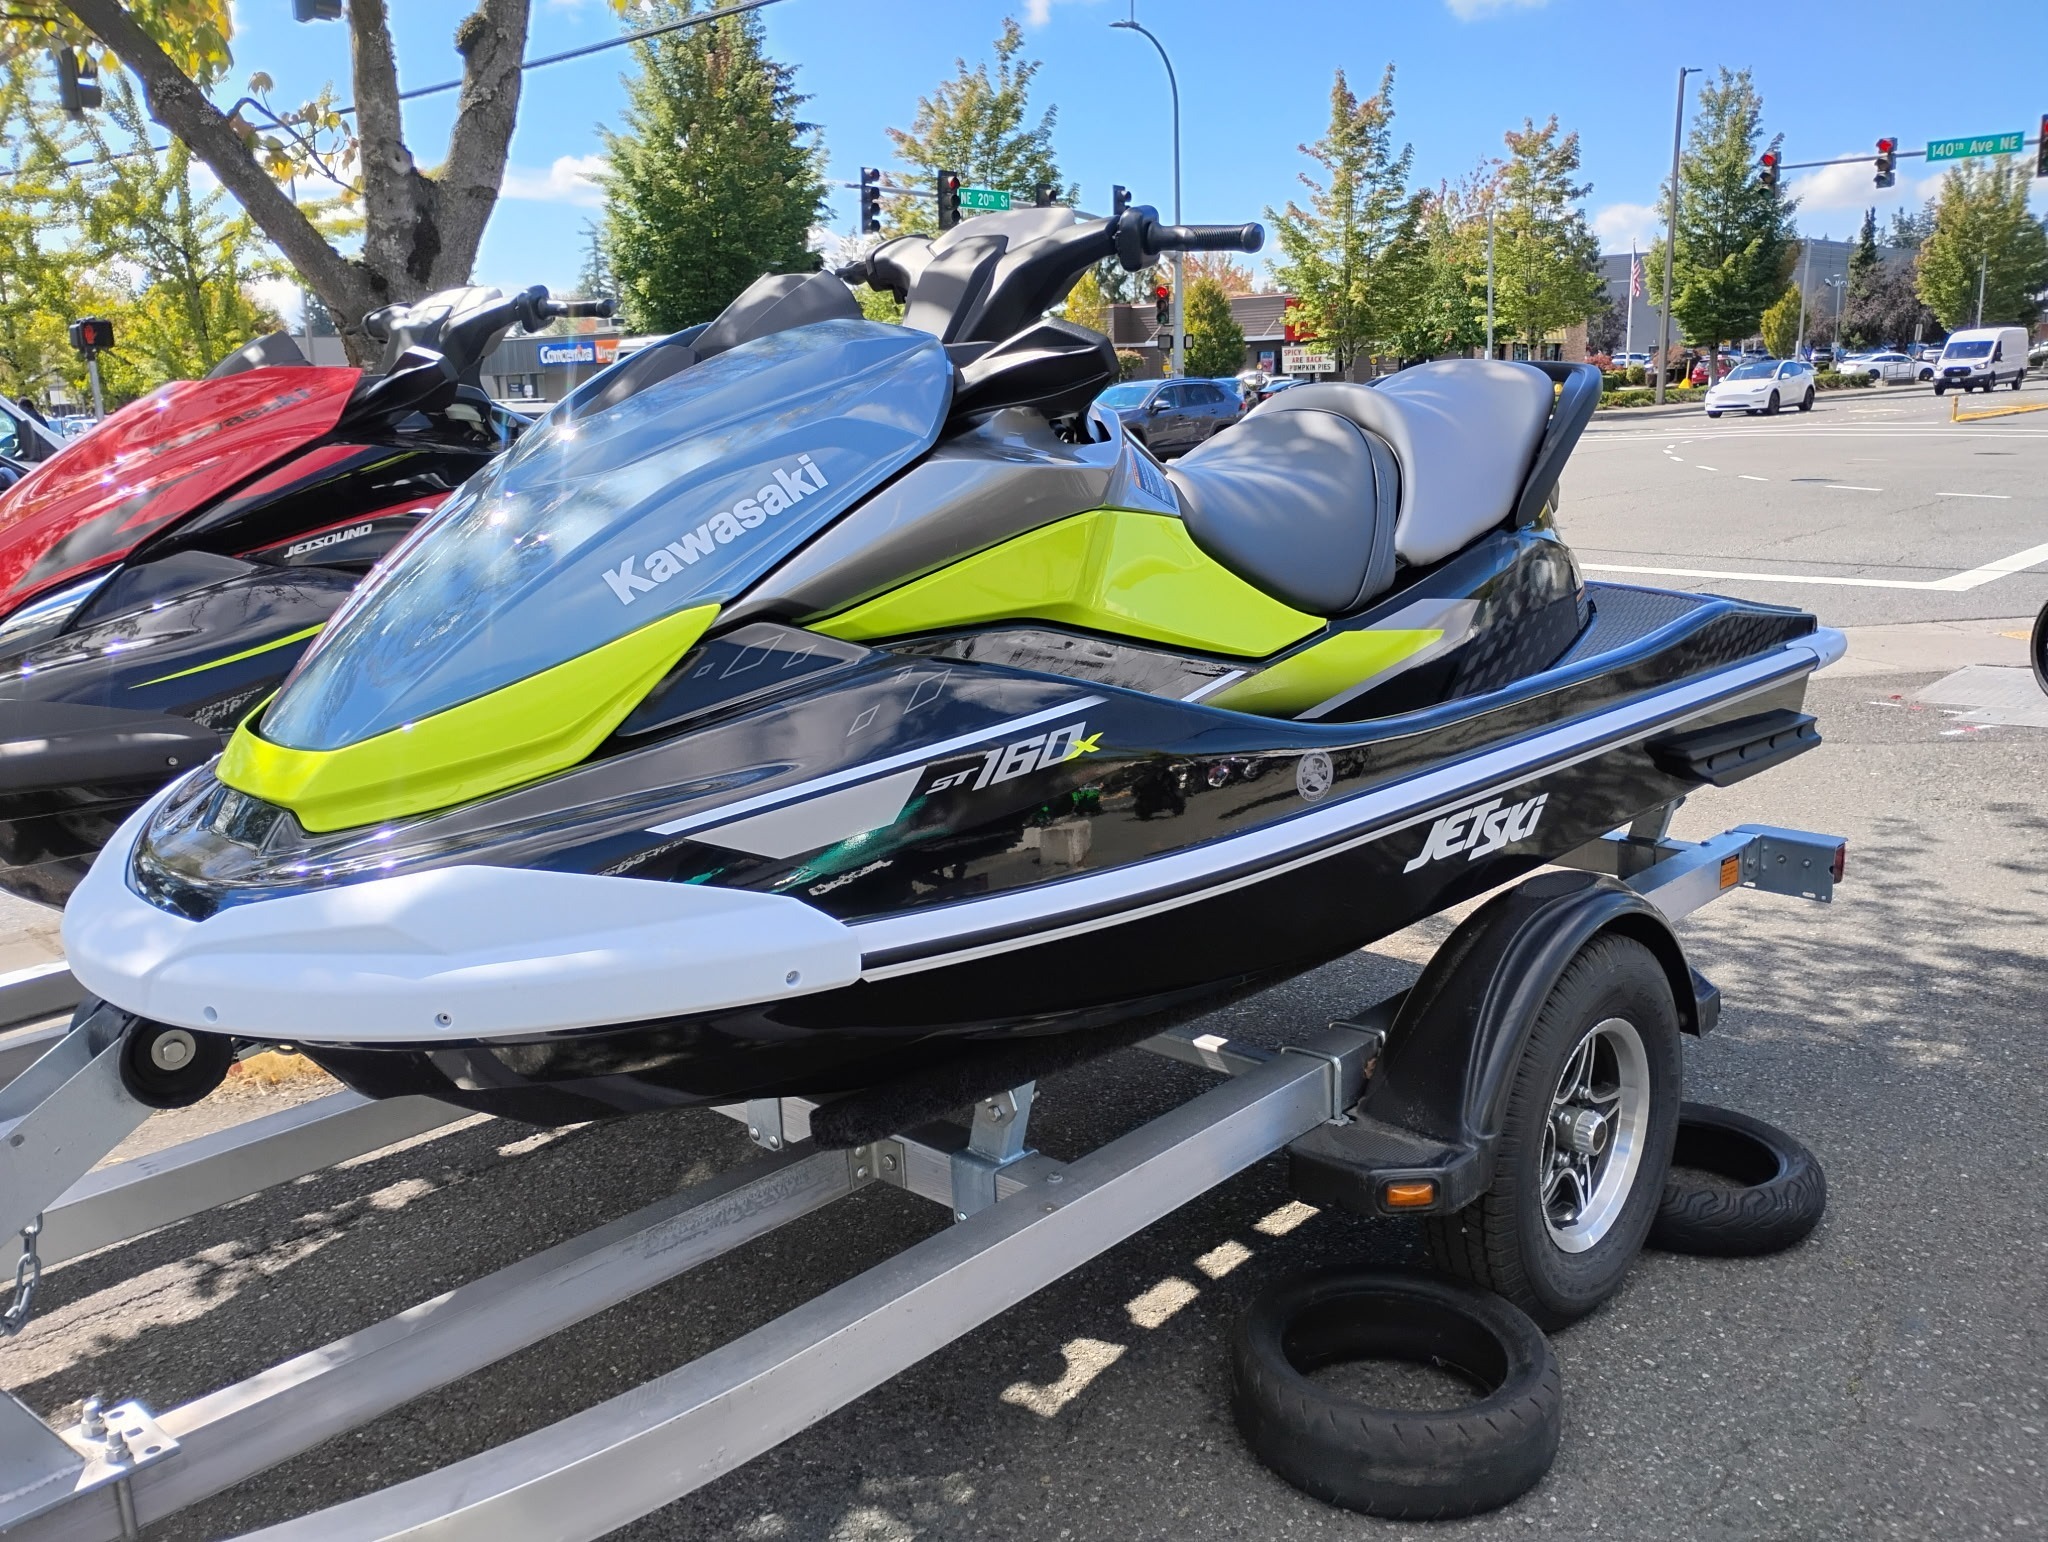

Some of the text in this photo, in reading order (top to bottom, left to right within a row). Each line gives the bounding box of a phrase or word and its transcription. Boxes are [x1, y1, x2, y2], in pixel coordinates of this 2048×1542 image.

[1932, 135, 2019, 157] 140th Ave NE
[961, 192, 1008, 207] NE 20th St
[284, 523, 373, 559] JETSOUND
[601, 454, 829, 606] Kawasaki
[925, 766, 979, 795] ST
